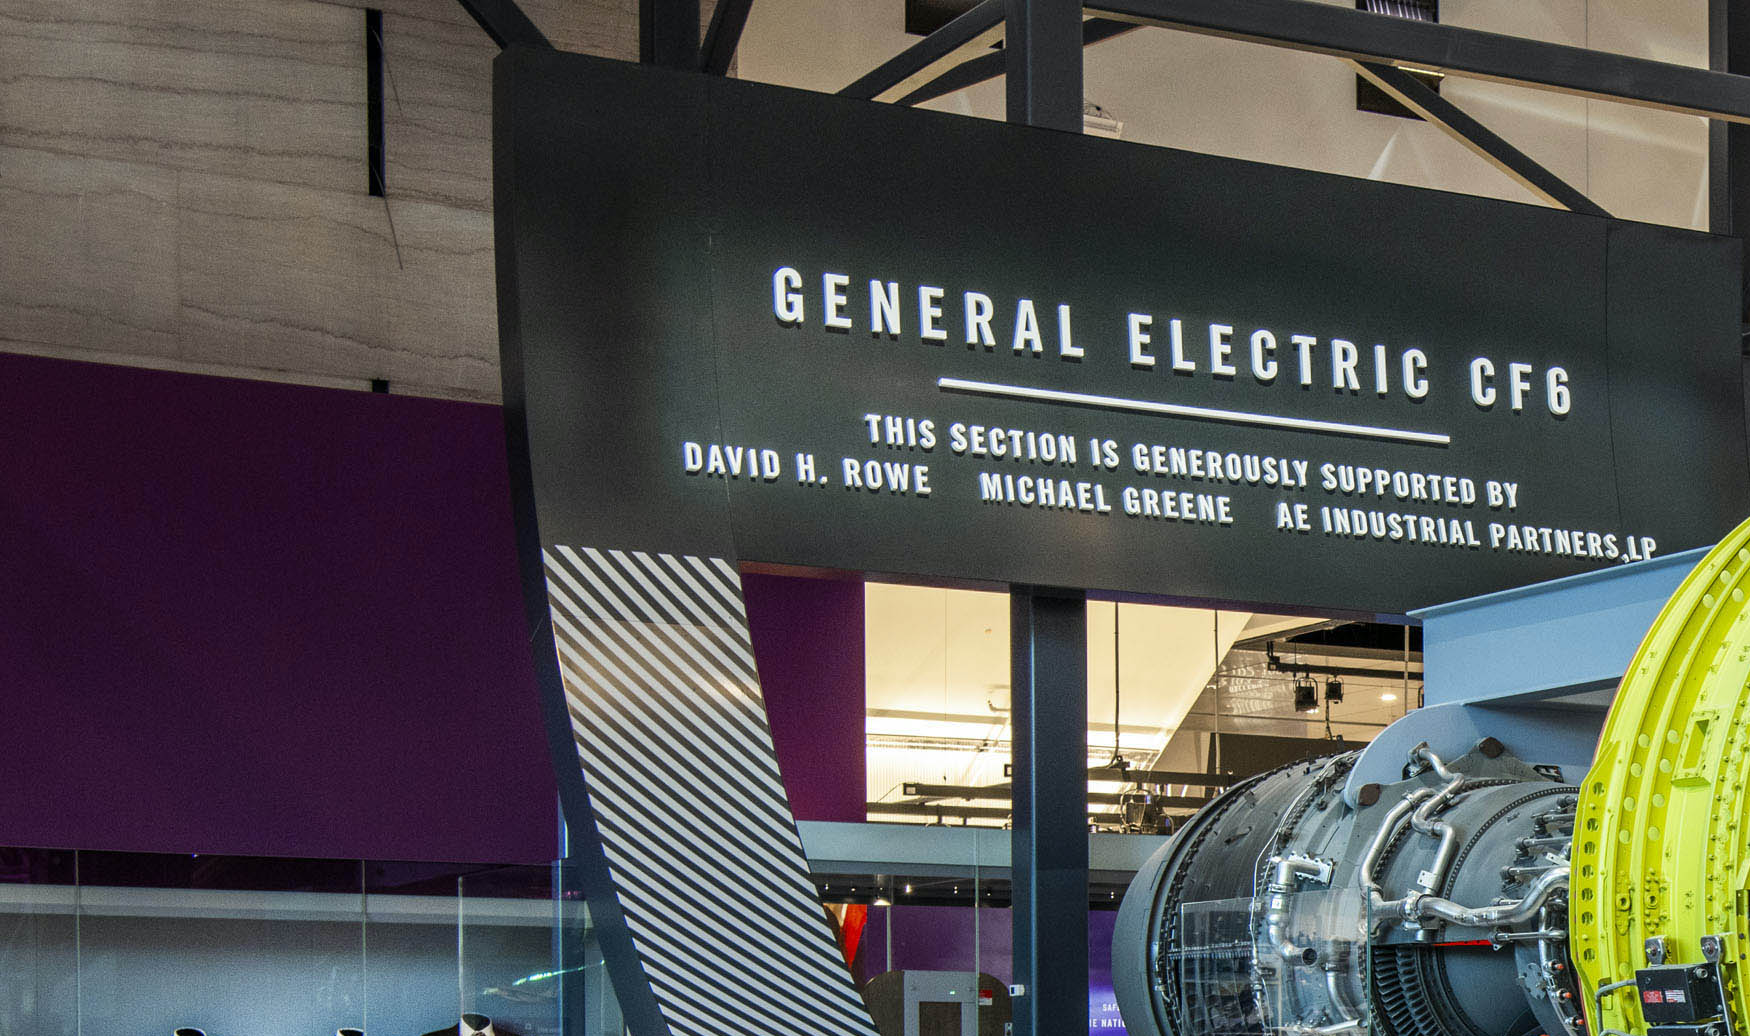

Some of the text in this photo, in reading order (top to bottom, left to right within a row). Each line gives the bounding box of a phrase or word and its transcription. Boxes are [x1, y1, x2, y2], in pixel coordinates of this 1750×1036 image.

[774, 268, 1570, 414] GENERAL ELECTRIC CF6
[684, 442, 931, 493] DAVID H. ROWE
[864, 414, 1517, 508] THIS SECTION IS GENEROUSLY SUPPORTED BY
[980, 473, 1233, 523] MICHAEL GREENE
[1278, 503, 1311, 530] AE
[1322, 507, 1480, 545] INDUSTRIAL
